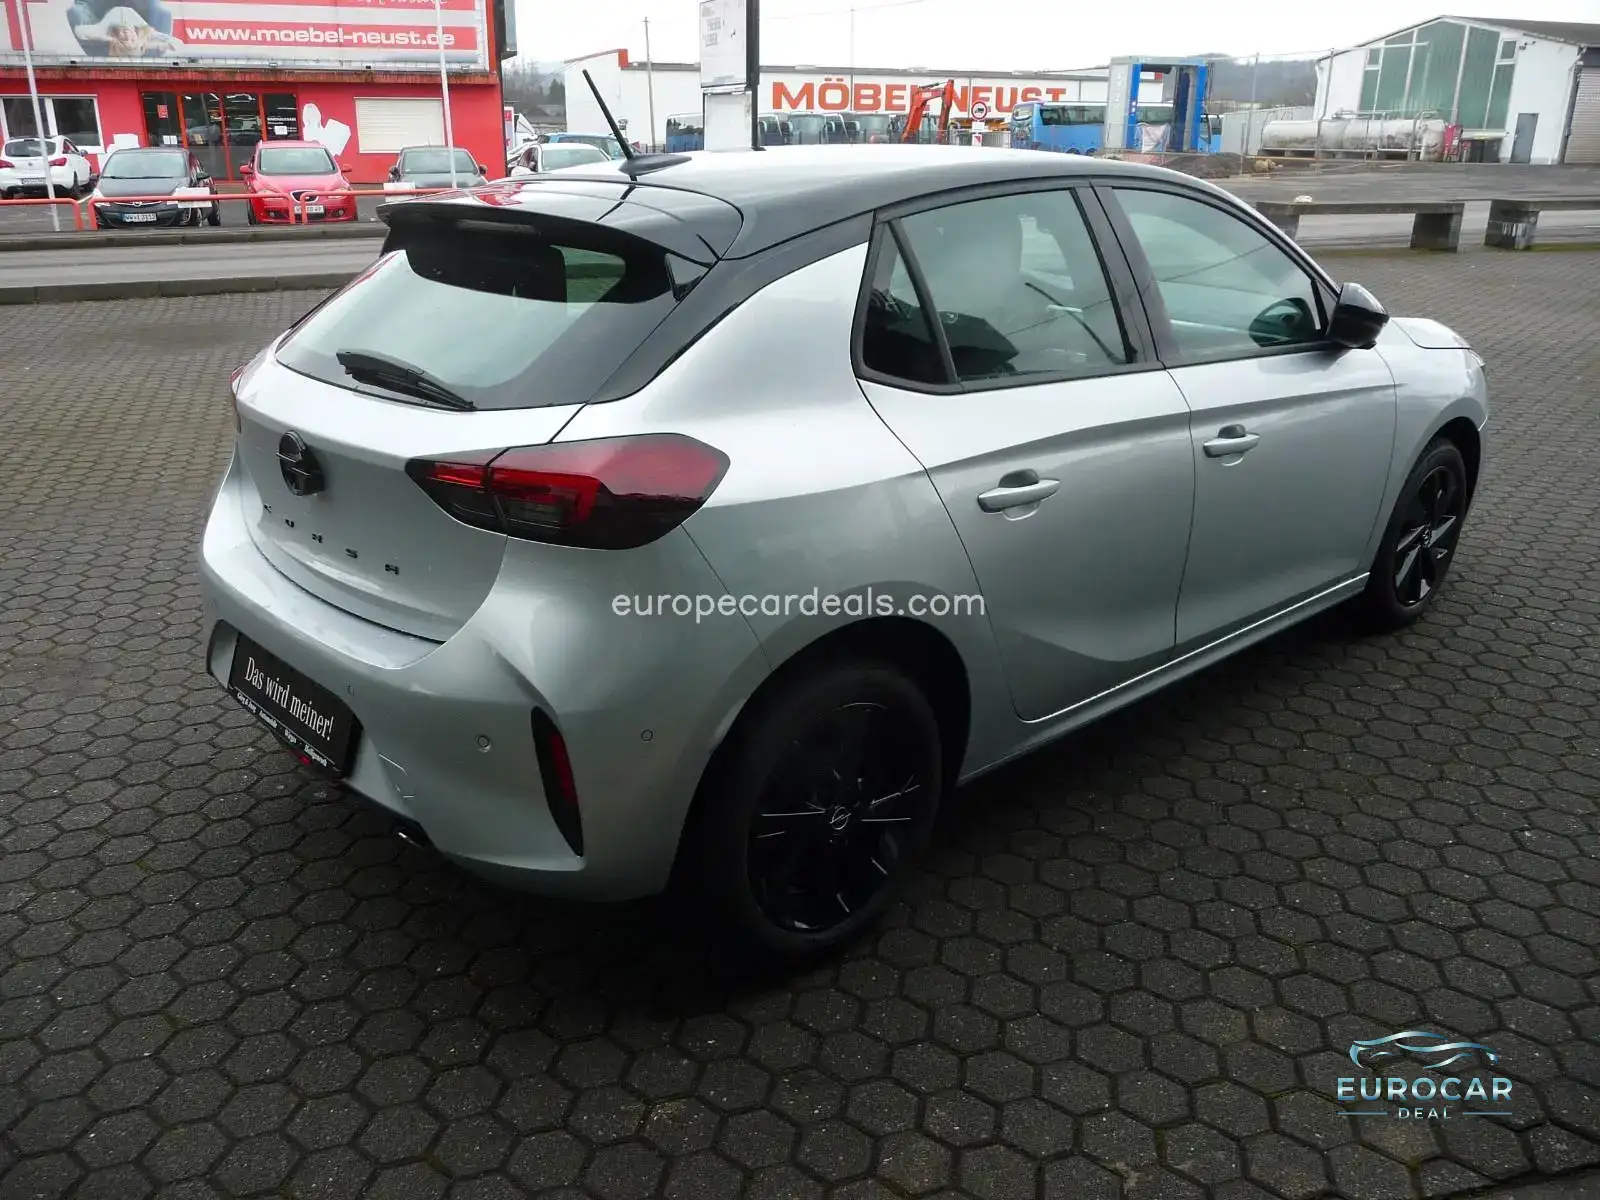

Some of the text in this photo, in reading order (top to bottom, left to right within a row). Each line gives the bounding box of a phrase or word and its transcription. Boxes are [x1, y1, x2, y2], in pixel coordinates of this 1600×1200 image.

[185, 26, 456, 46] www.moebel-neust.de
[244, 656, 265, 690] Das
[265, 677, 291, 709] wird
[289, 695, 334, 741] meiner!
